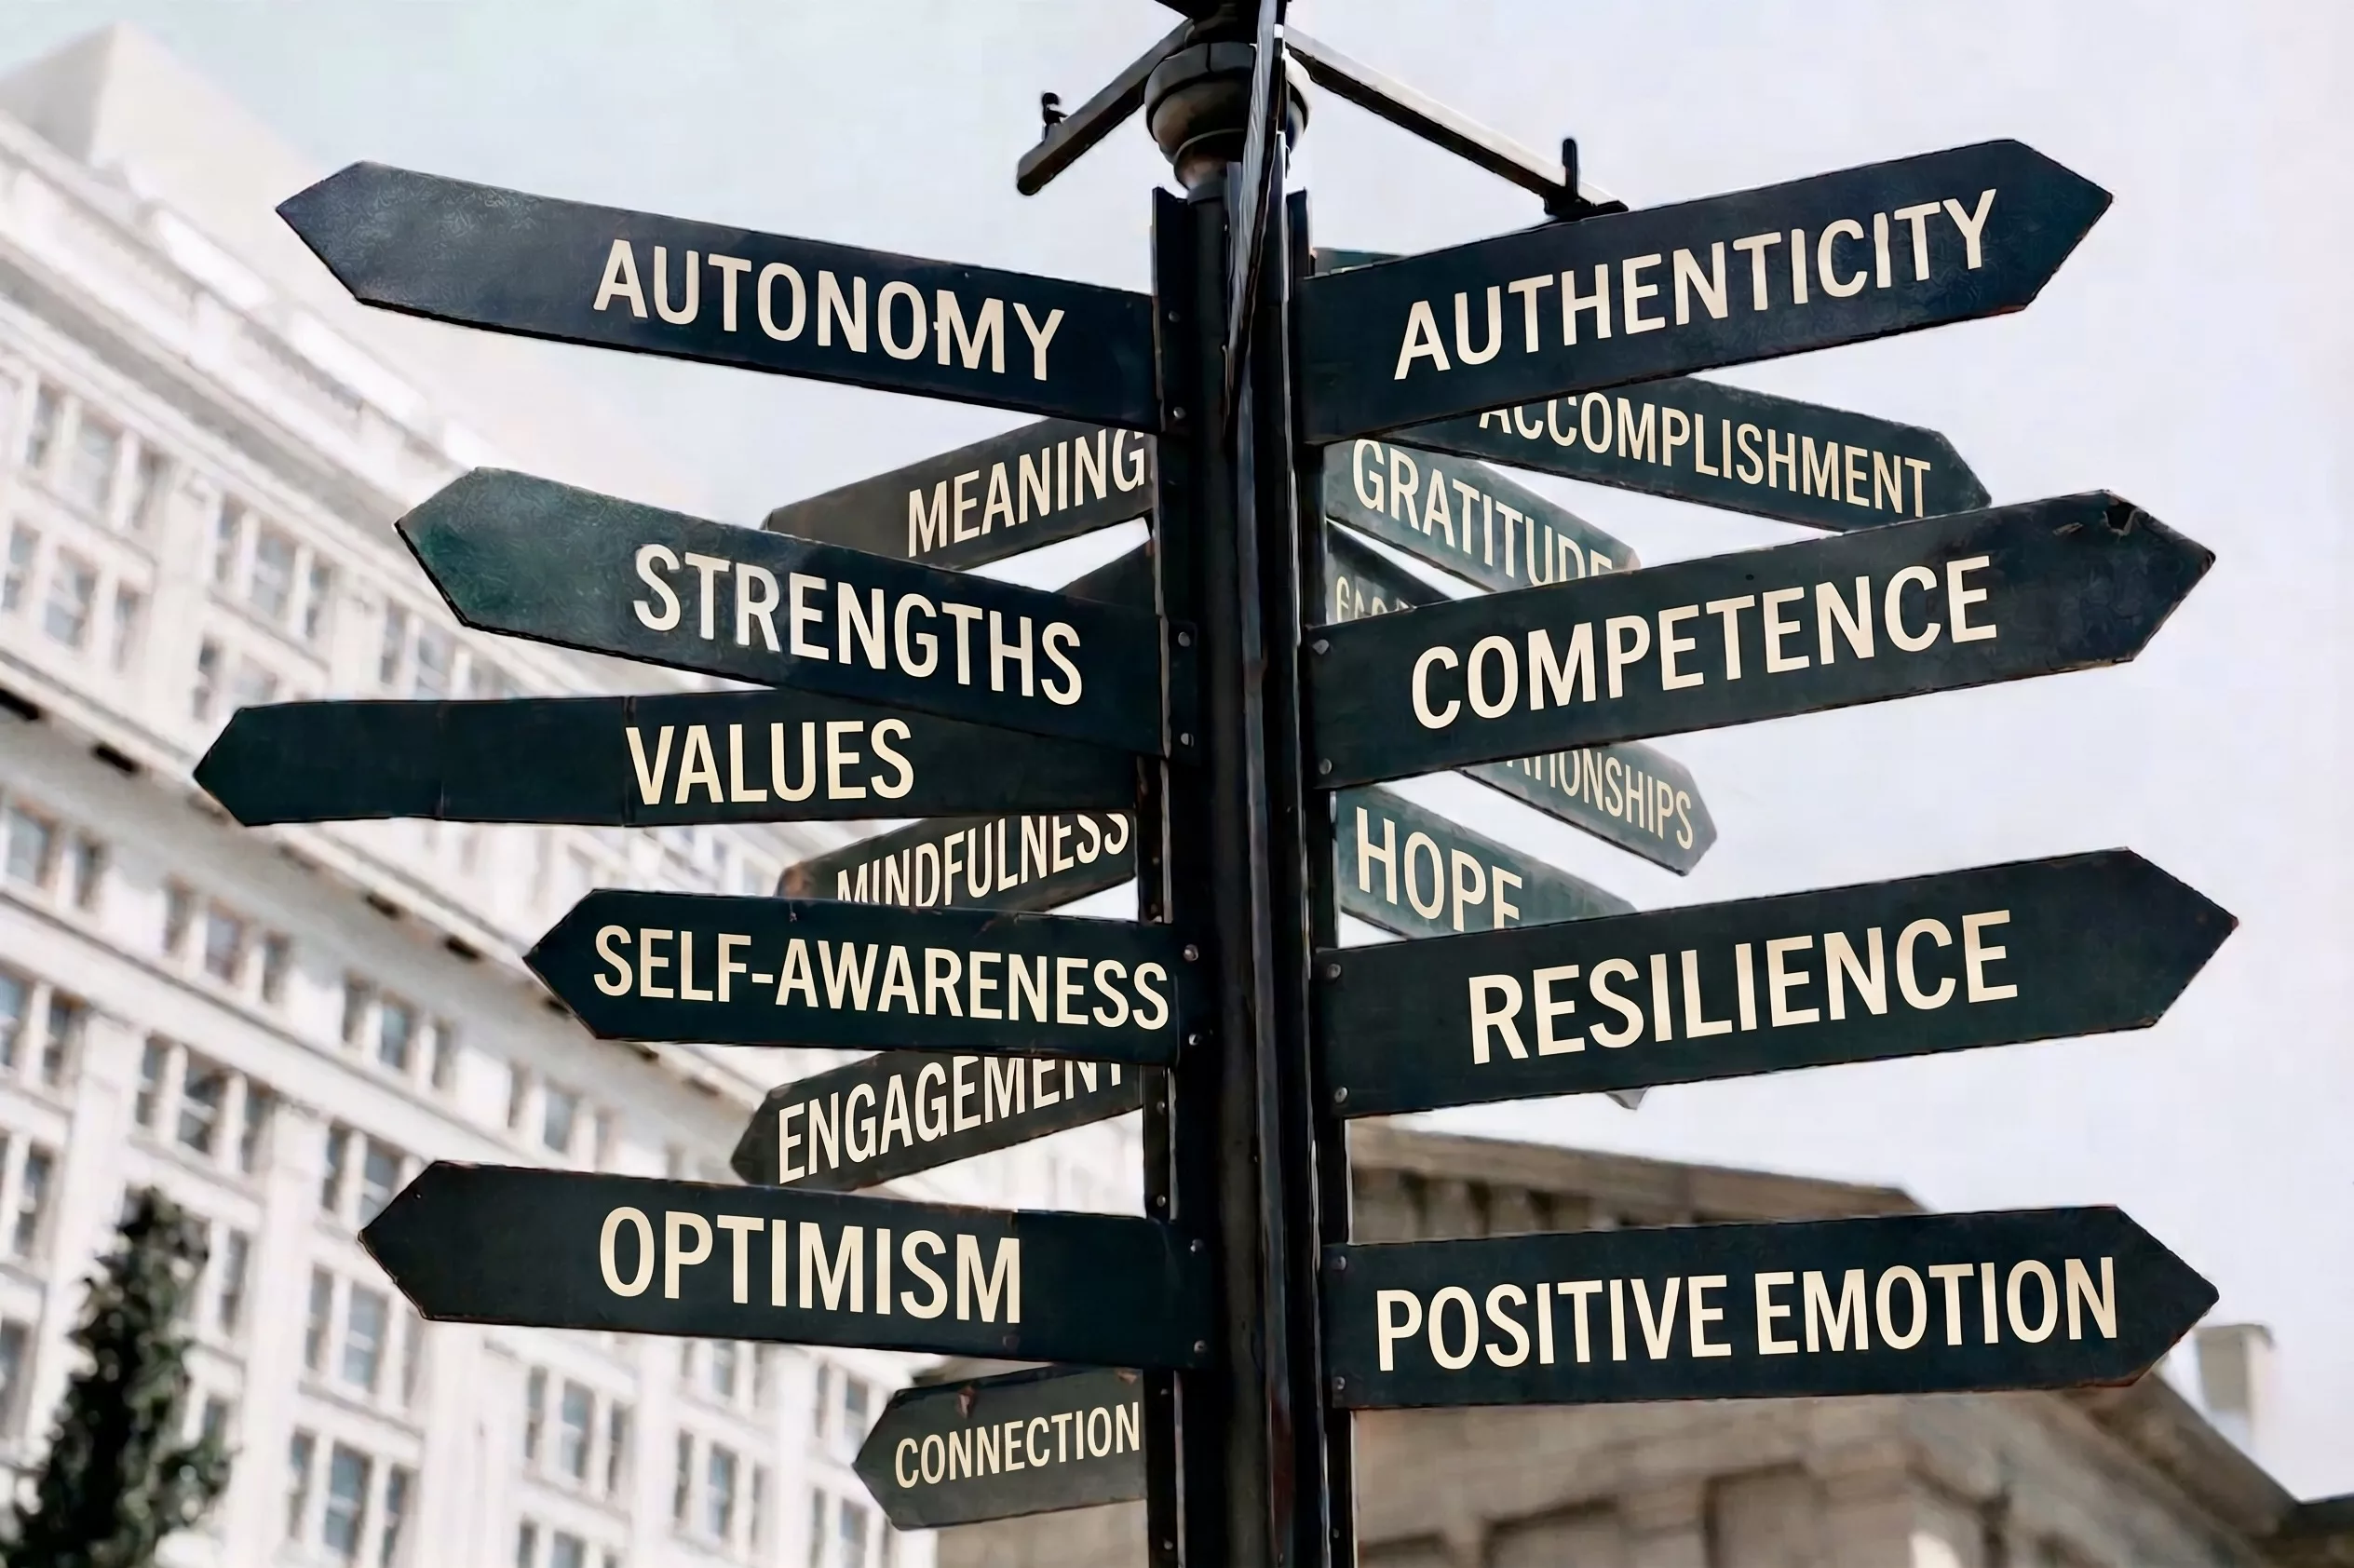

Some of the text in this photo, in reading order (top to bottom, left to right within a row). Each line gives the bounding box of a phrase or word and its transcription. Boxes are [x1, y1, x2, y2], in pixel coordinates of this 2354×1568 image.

[595, 238, 1063, 381] AUTONOMY
[1395, 188, 1995, 380] AUTHENTICITY
[908, 428, 1145, 559] MEANING
[633, 544, 1082, 706] STRENGTHS
[1412, 554, 1997, 729] COMPETENCE
[625, 718, 914, 805] VALUES
[594, 925, 1169, 1031] SELF-AWARENESS
[1469, 909, 2018, 1068] RESILIENCE
[599, 1207, 1021, 1325] OPTIMISM
[1376, 1256, 2117, 1372] POSITIVE EMOTION
[895, 1401, 1140, 1489] CONNECTION
